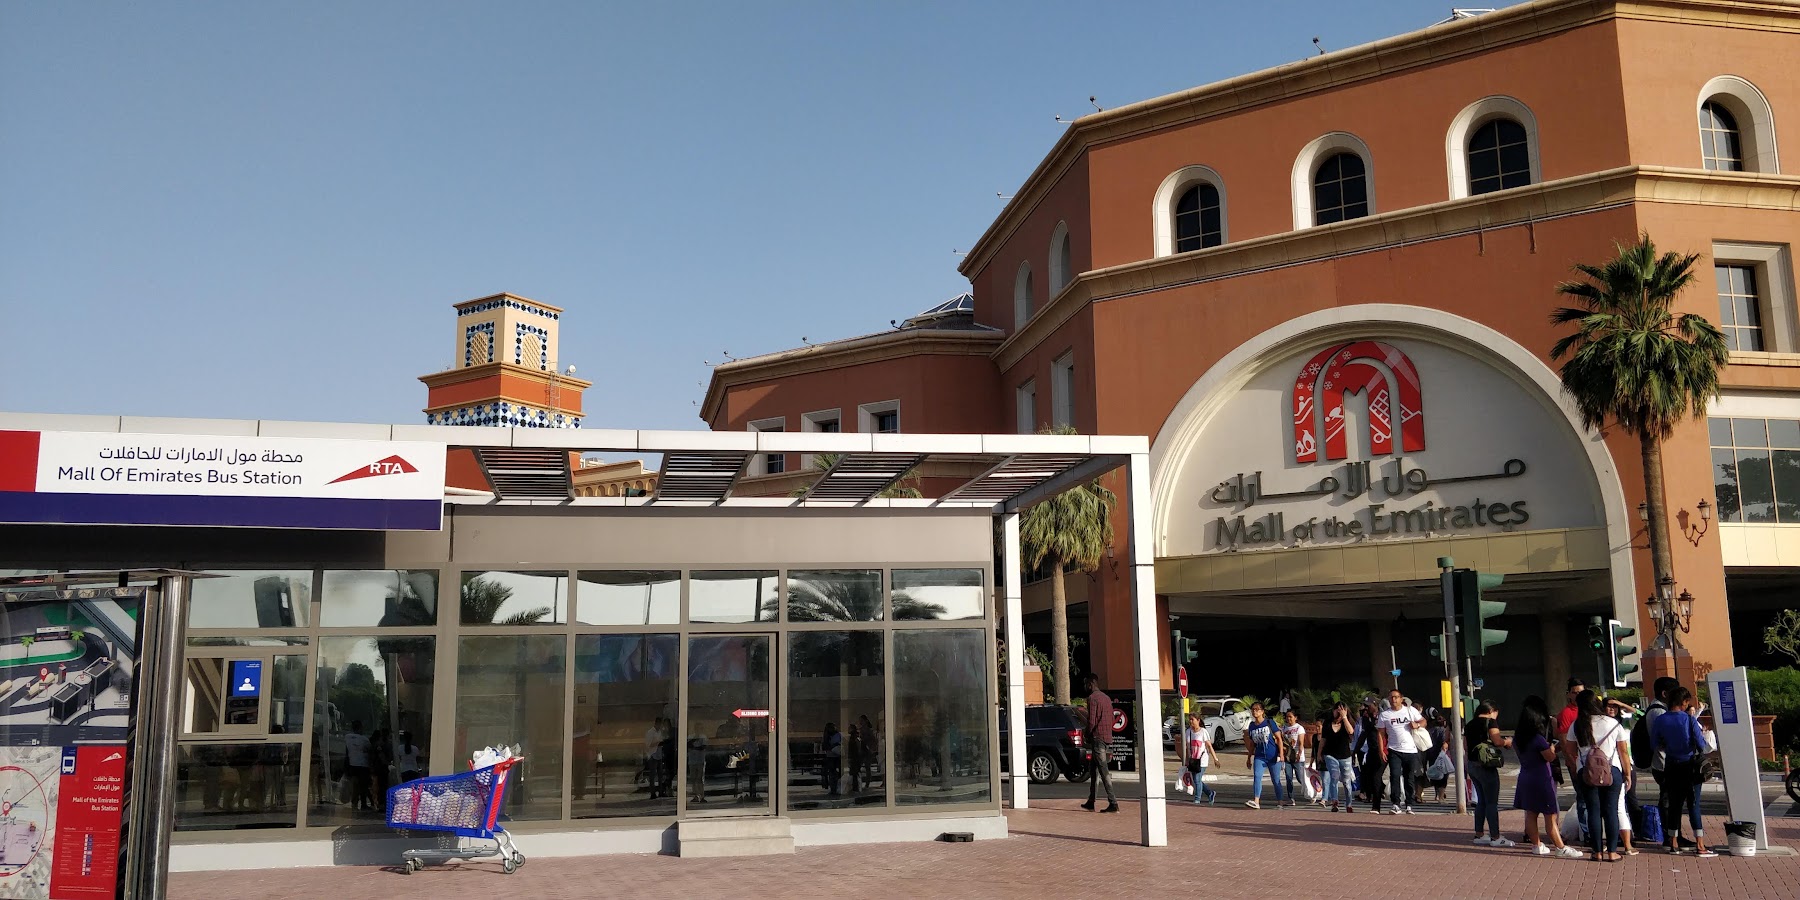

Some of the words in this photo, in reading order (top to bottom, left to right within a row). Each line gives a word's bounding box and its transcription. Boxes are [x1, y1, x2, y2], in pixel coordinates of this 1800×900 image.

[99, 446, 161, 460] للحافلات
[166, 447, 223, 464] الامارات
[226, 448, 257, 465] مول
[261, 449, 303, 463] محطة
[58, 466, 95, 481] Mall
[100, 467, 123, 481] Of
[126, 468, 203, 483] Emirates
[207, 469, 238, 483] Bus
[242, 470, 302, 485] Station
[369, 462, 404, 474] RTA
[1383, 457, 1527, 496] مول
[1215, 511, 1286, 546] Mall
[1293, 517, 1317, 540] of
[1323, 515, 1363, 538] the
[1369, 497, 1529, 535] Emirates
[1390, 717, 1408, 725] FILA
